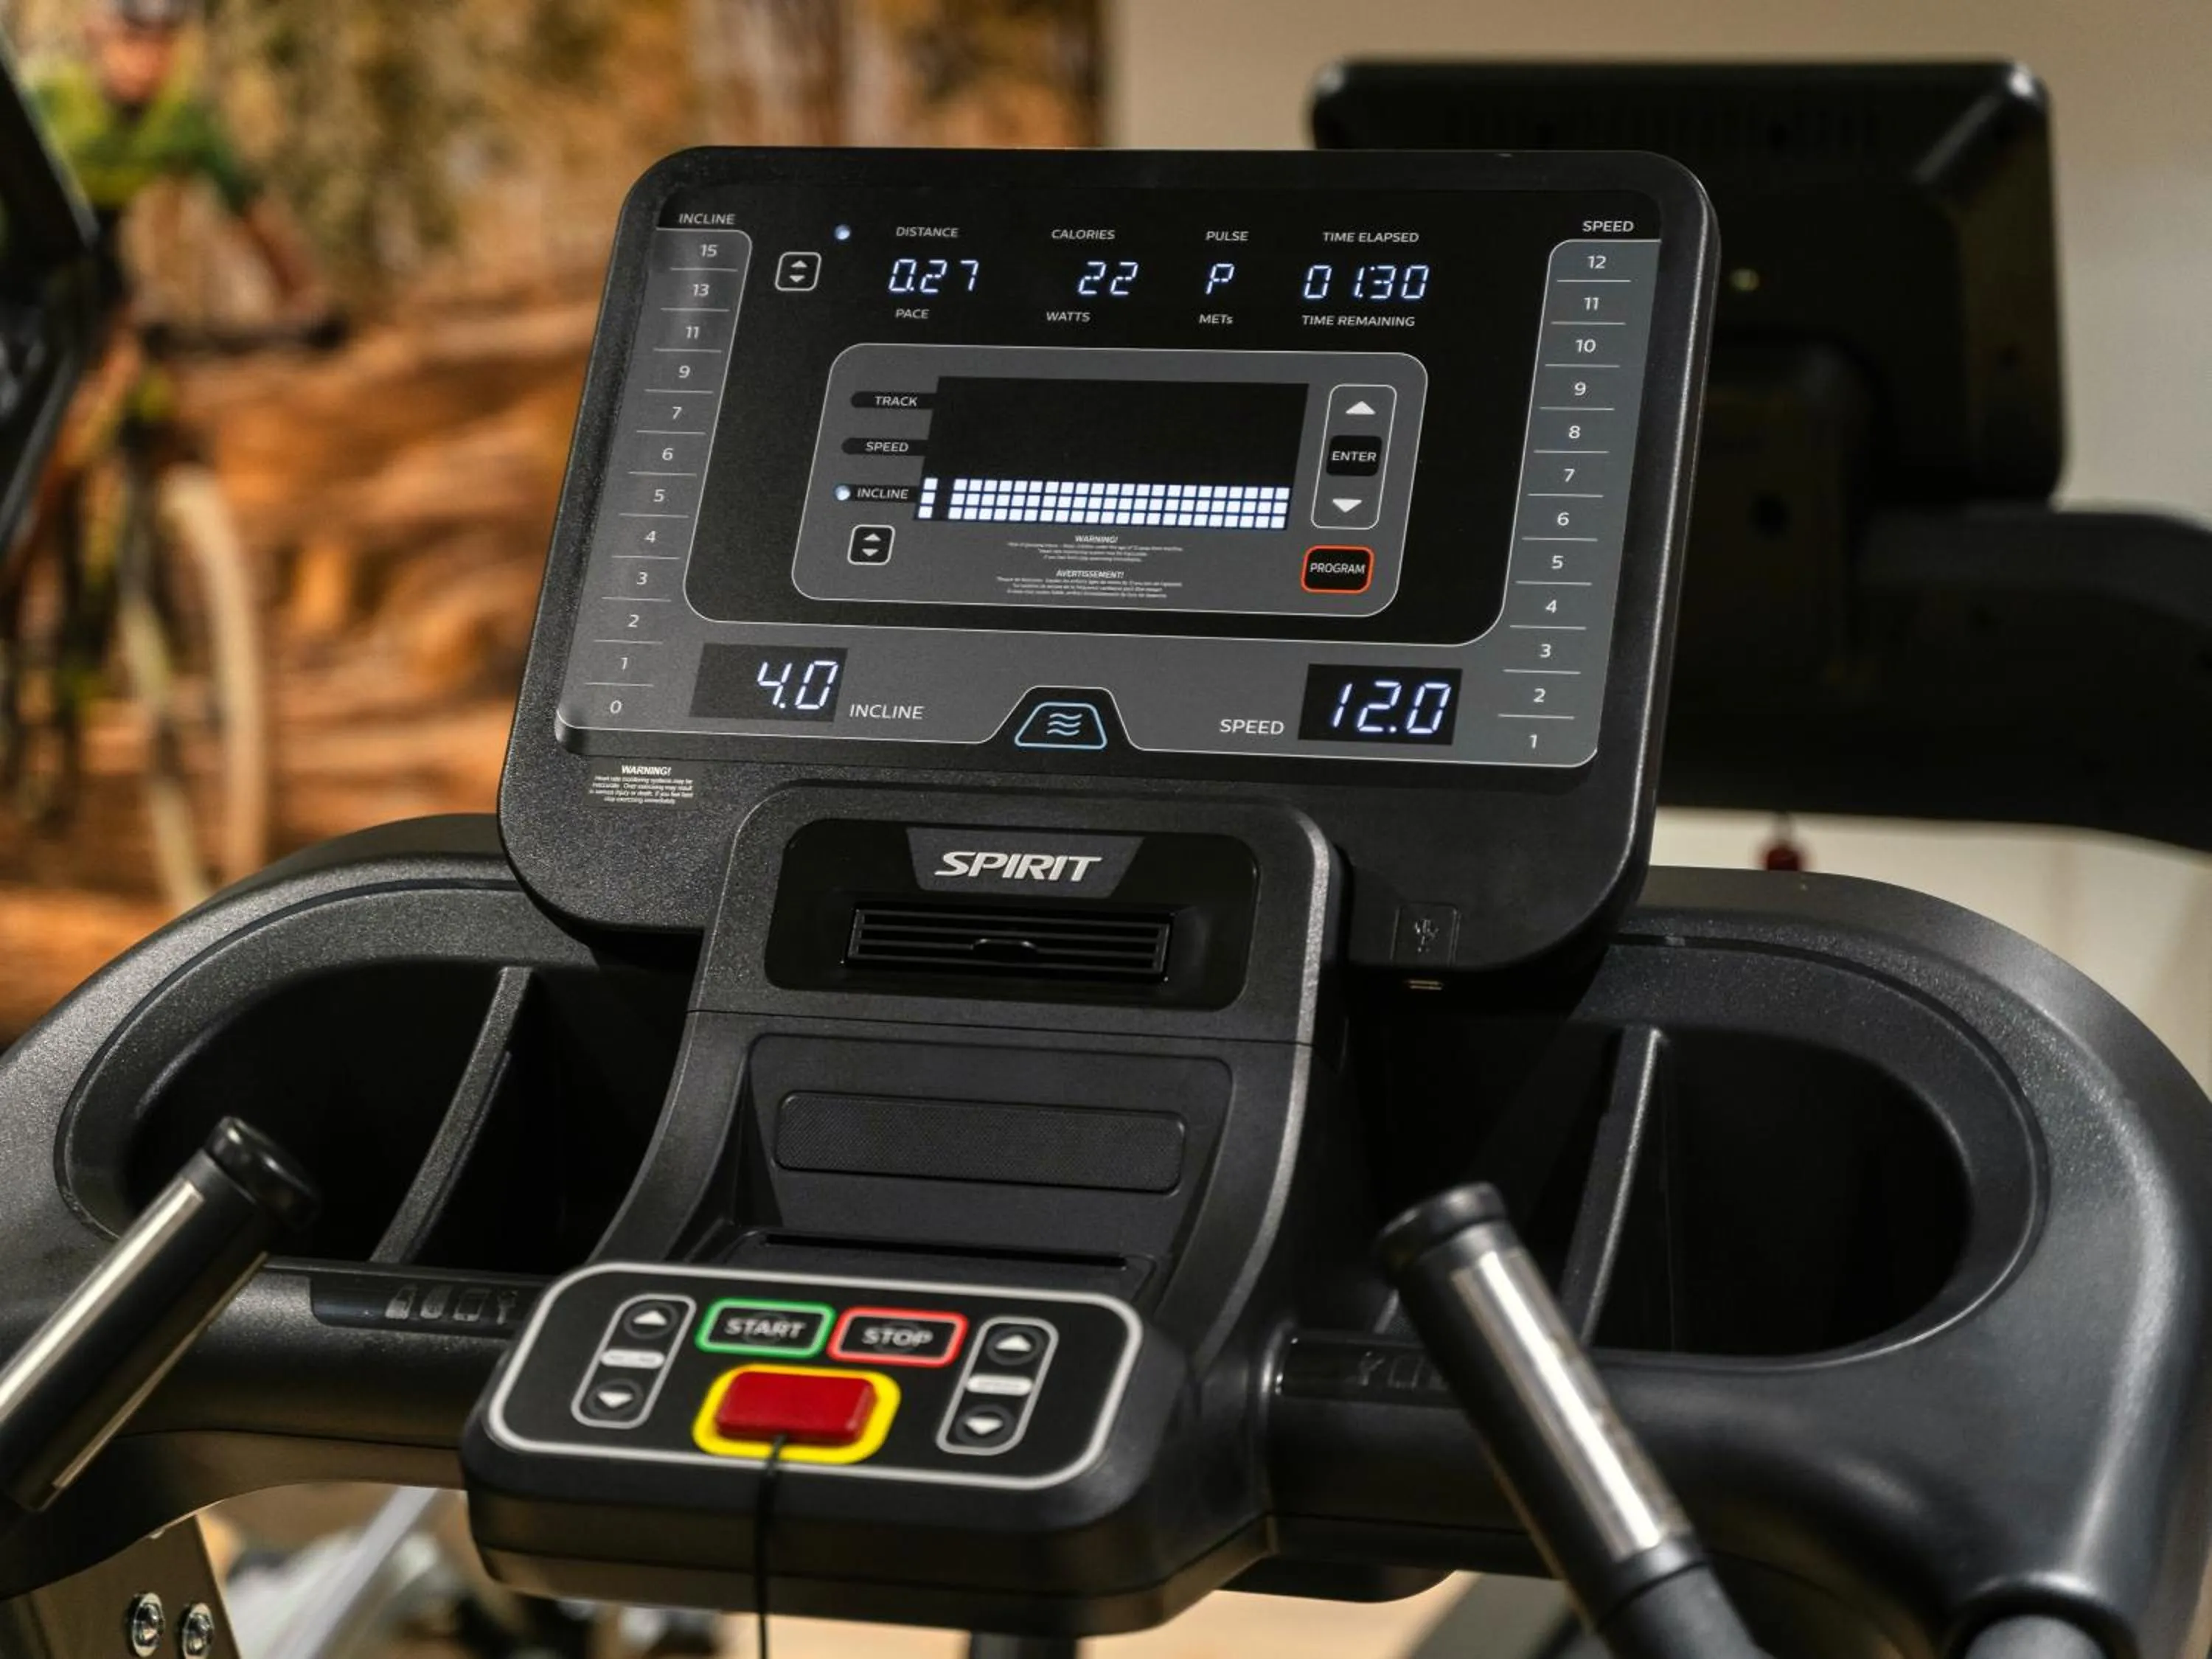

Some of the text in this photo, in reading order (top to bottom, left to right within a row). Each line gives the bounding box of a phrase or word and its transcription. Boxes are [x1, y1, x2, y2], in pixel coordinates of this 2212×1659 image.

[678, 213, 735, 225] INCLINE
[1582, 220, 1634, 232] SPEED
[896, 226, 959, 238] DISTANCE
[1051, 229, 1116, 240] CALORIES
[1206, 231, 1249, 241] PULSE
[1323, 232, 1419, 243] TIME ELAPSED
[700, 243, 717, 257] 15
[1587, 255, 1607, 269] 12
[888, 258, 979, 293] 0.27
[1078, 261, 1138, 296] 22
[1206, 263, 1235, 295] P
[692, 283, 709, 297] 13
[1584, 296, 1599, 310] 11
[895, 308, 930, 319] PACE
[1046, 311, 1091, 322] WATTS
[1198, 313, 1233, 324] METs
[1301, 315, 1415, 327] TIME REMAINING
[686, 325, 700, 339] 11
[1576, 338, 1596, 353] 10
[678, 365, 691, 378] 9
[1574, 381, 1587, 396] 9
[875, 395, 918, 407] TRACK
[672, 406, 682, 420] 7
[1568, 425, 1581, 439] 8
[866, 441, 909, 453] SPEED
[661, 448, 673, 461] 6
[1332, 451, 1377, 462] ENTER
[1564, 468, 1576, 482] 7
[653, 489, 665, 502] 5
[857, 487, 909, 499] INCLINE
[1557, 512, 1570, 526] 6
[644, 530, 656, 543] 4
[1074, 535, 1119, 543] WARNING!
[1309, 562, 1366, 574] PROGRAM
[1551, 554, 1564, 569] 5
[636, 571, 648, 585] 3
[1545, 599, 1557, 613] 4
[627, 613, 640, 628] 2
[1540, 643, 1552, 658] 3
[621, 657, 628, 670] 1
[757, 660, 838, 710] 4.0
[1533, 688, 1546, 703] 2
[609, 700, 622, 714] 0
[849, 703, 924, 720] INCLINE
[1332, 681, 1452, 734] 12.0
[1220, 719, 1284, 735] SPEED
[1530, 734, 1537, 748] 1
[622, 765, 672, 776] WARNING!
[934, 851, 1102, 882] SPIRIT
[725, 1318, 805, 1338] START
[862, 1326, 934, 1347] STOP
